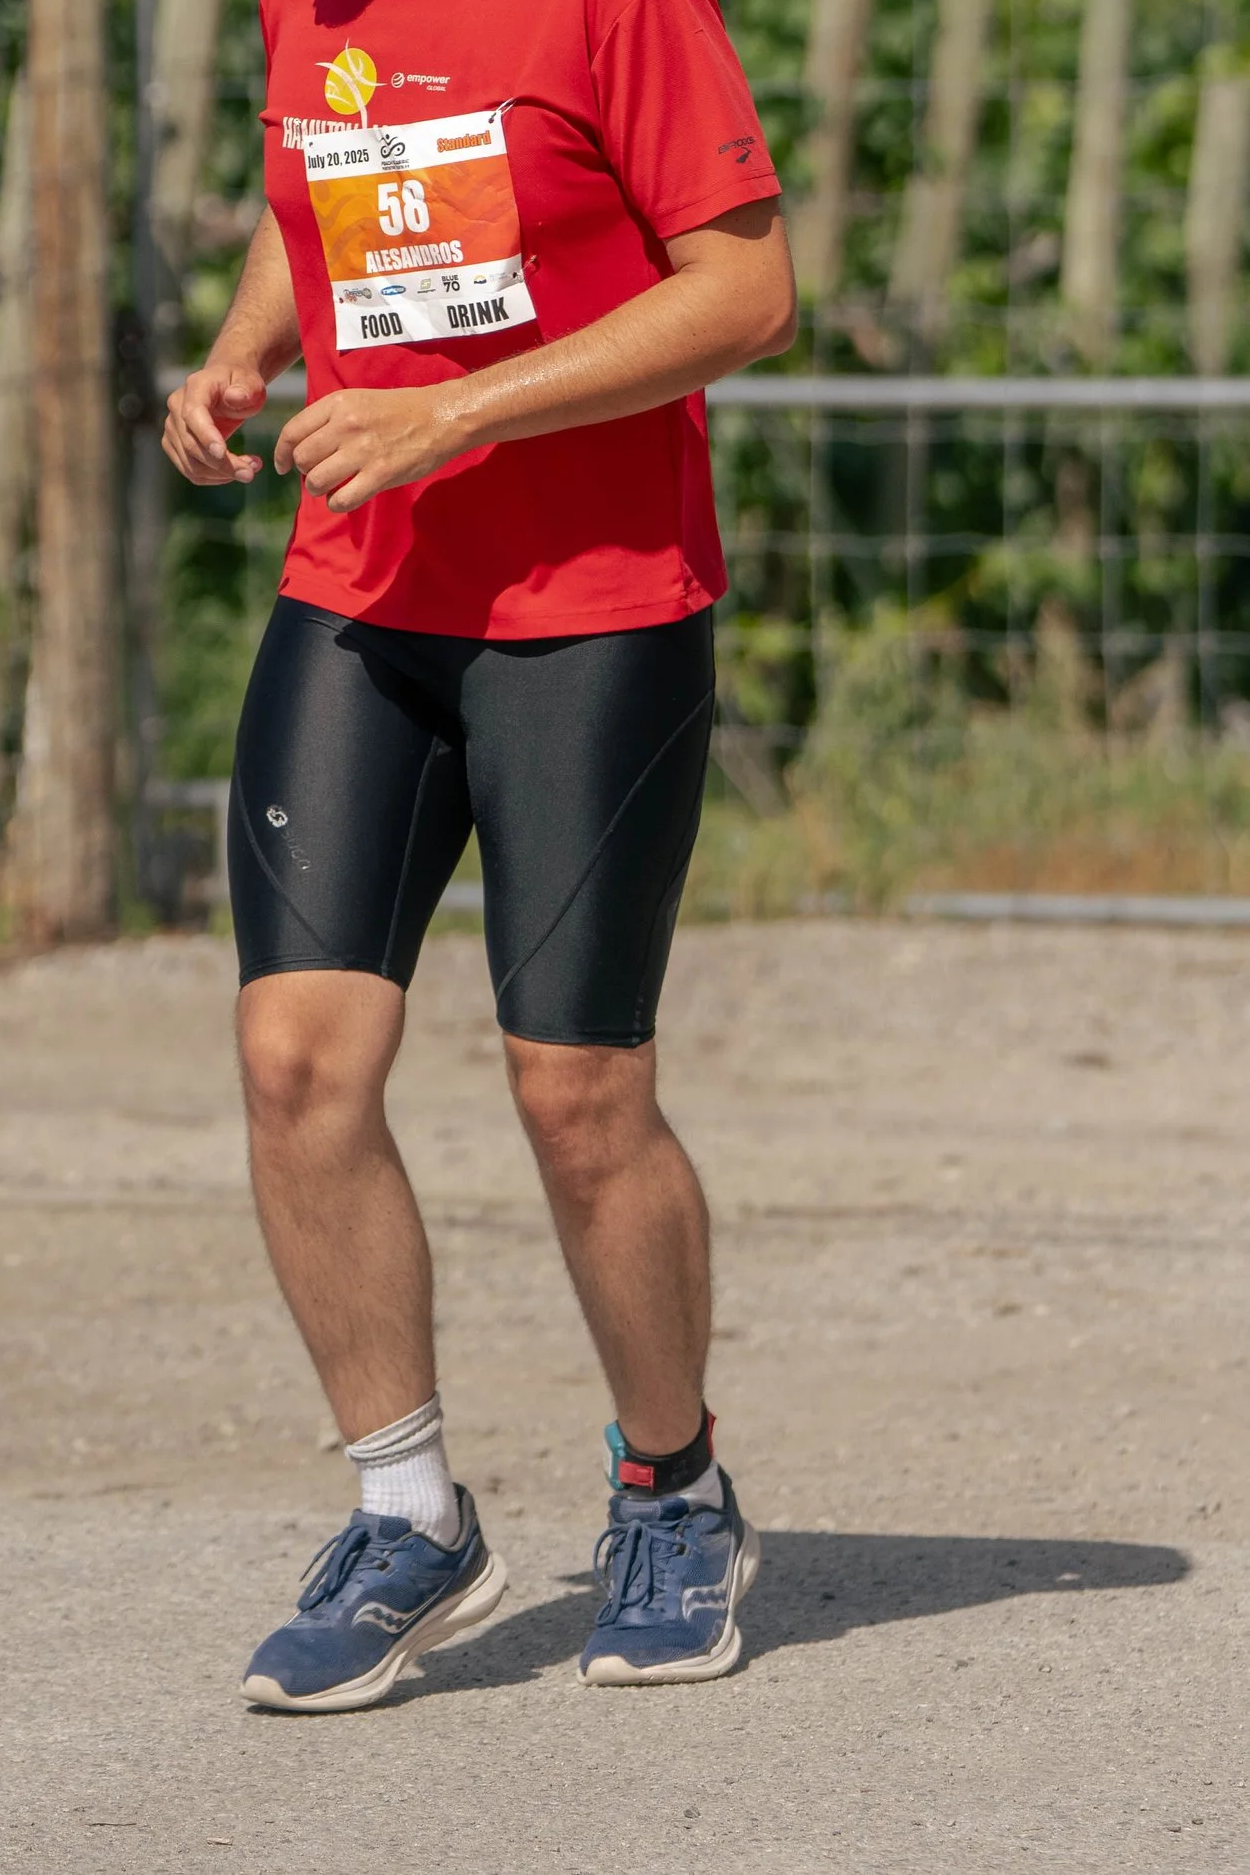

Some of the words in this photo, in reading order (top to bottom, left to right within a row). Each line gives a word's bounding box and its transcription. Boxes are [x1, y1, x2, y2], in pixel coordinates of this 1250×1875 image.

[407, 74, 450, 85] empower
[282, 117, 359, 150] HAMI
[437, 130, 492, 153] Standard
[308, 154, 325, 169] July
[327, 152, 342, 167] 20,
[344, 149, 369, 165] 2025
[377, 179, 430, 236] 58
[365, 239, 464, 274] ALESANDROS
[443, 281, 460, 292] 70
[360, 312, 403, 339] FOOD
[447, 297, 510, 329] DRINK
